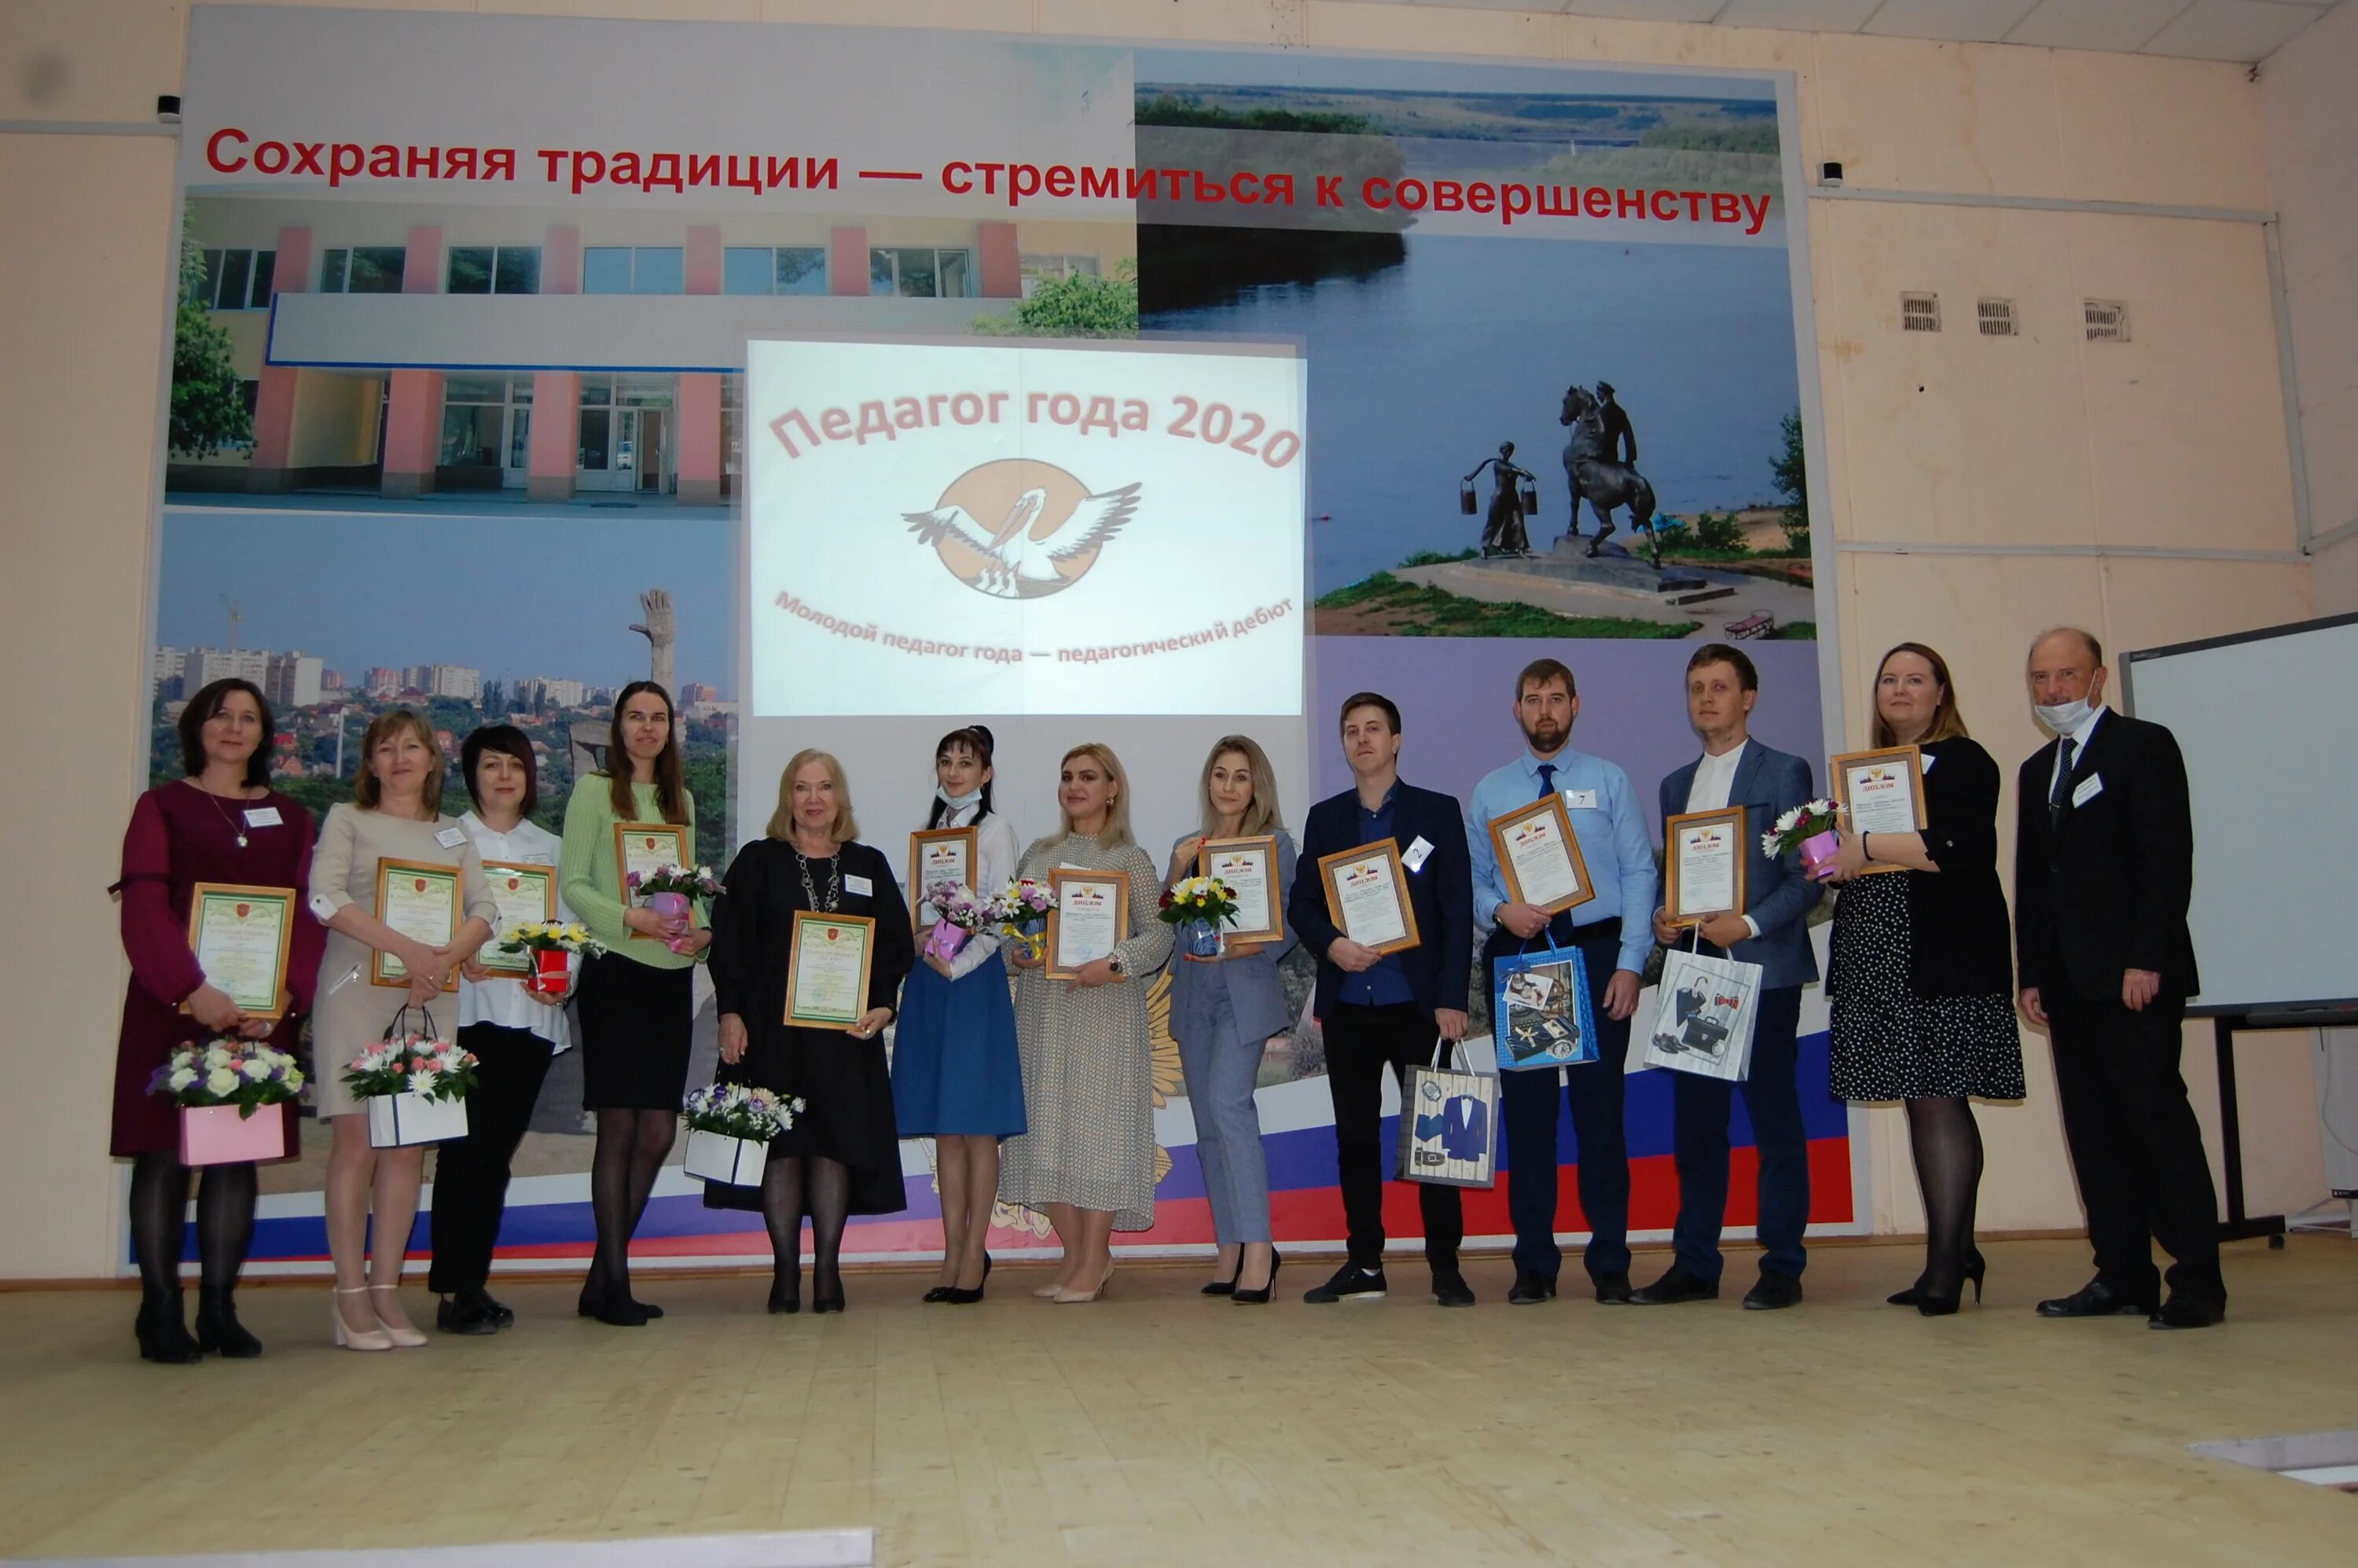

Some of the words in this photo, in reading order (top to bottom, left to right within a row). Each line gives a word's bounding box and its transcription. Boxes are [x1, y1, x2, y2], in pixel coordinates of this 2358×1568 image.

[206, 128, 516, 188] Сохраняя
[537, 149, 839, 196] традиции
[942, 161, 1295, 207] стремиться
[1317, 175, 1344, 207] к
[1361, 177, 1771, 237] совершенству
[769, 391, 1009, 459] Педагог
[1027, 393, 1149, 438] года
[1167, 396, 1302, 469] 2020
[775, 590, 878, 642] Молодой
[883, 631, 969, 655] педагог
[974, 645, 1023, 664] года
[1058, 622, 1229, 664] педагогический
[1232, 597, 1293, 637] дебют
[1579, 795, 1585, 805] 7
[1863, 781, 1894, 792] ДИПЛОМ
[1412, 848, 1422, 858] 2
